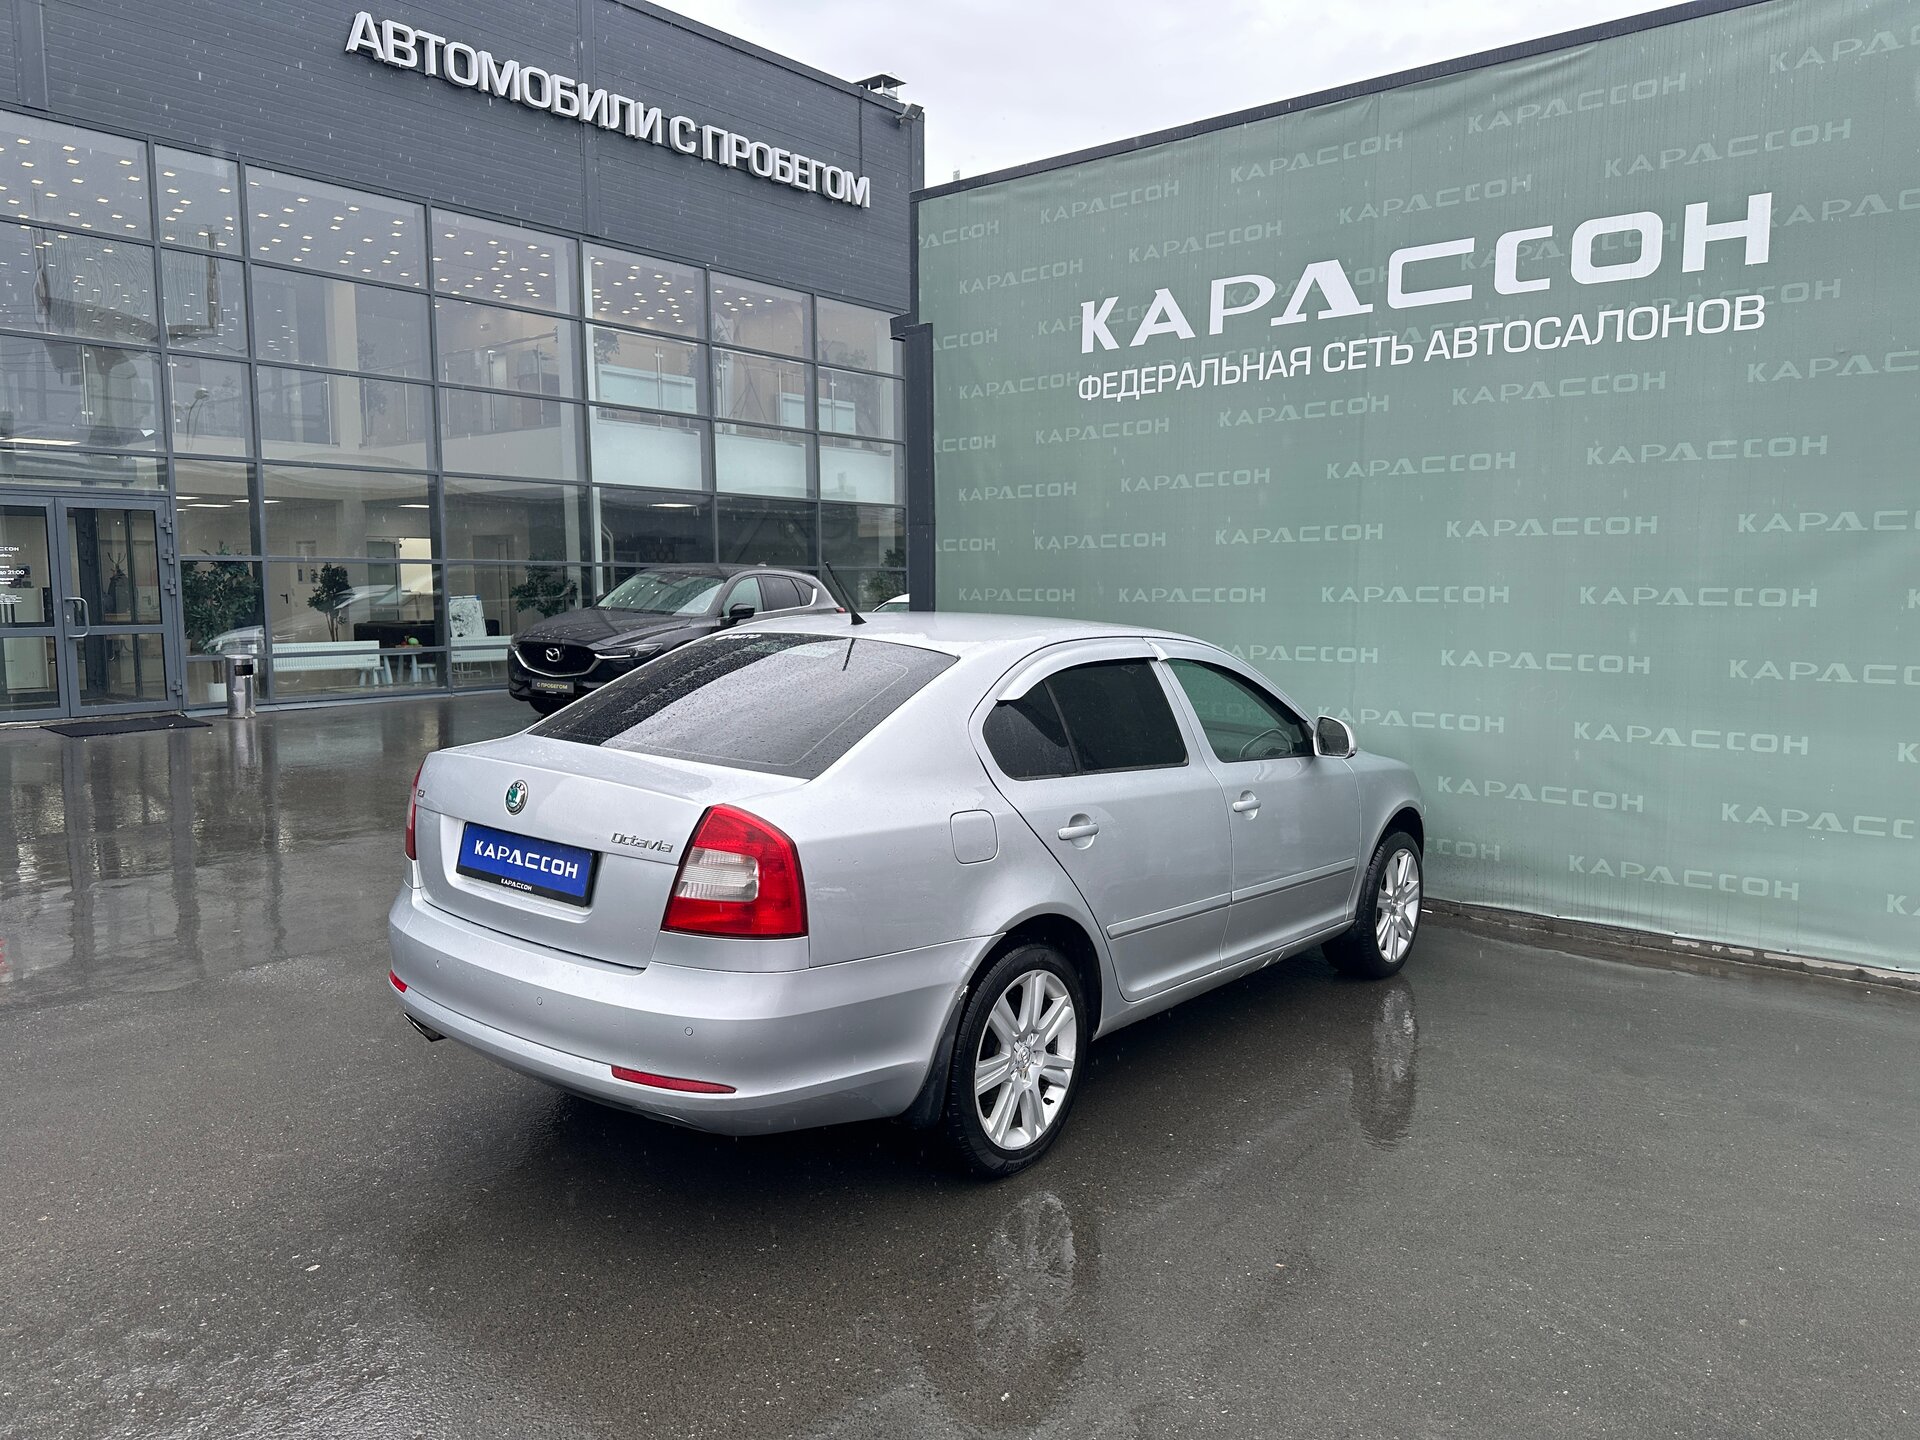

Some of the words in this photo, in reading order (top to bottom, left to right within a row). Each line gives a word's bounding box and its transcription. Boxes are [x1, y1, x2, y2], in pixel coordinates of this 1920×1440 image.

[345, 12, 662, 145] АВТОМОБИЛИ
[669, 115, 697, 155] С
[701, 124, 871, 209] ПРОБЕГОМ
[1078, 346, 1312, 402] ФЕДЕРАЛЬНАЯ
[1322, 335, 1414, 373] СЕТЬ
[1423, 294, 1766, 363] АВТОСАЛОНОВ
[1217, 644, 1379, 665] АРЛССОН
[611, 832, 674, 853] Octavia
